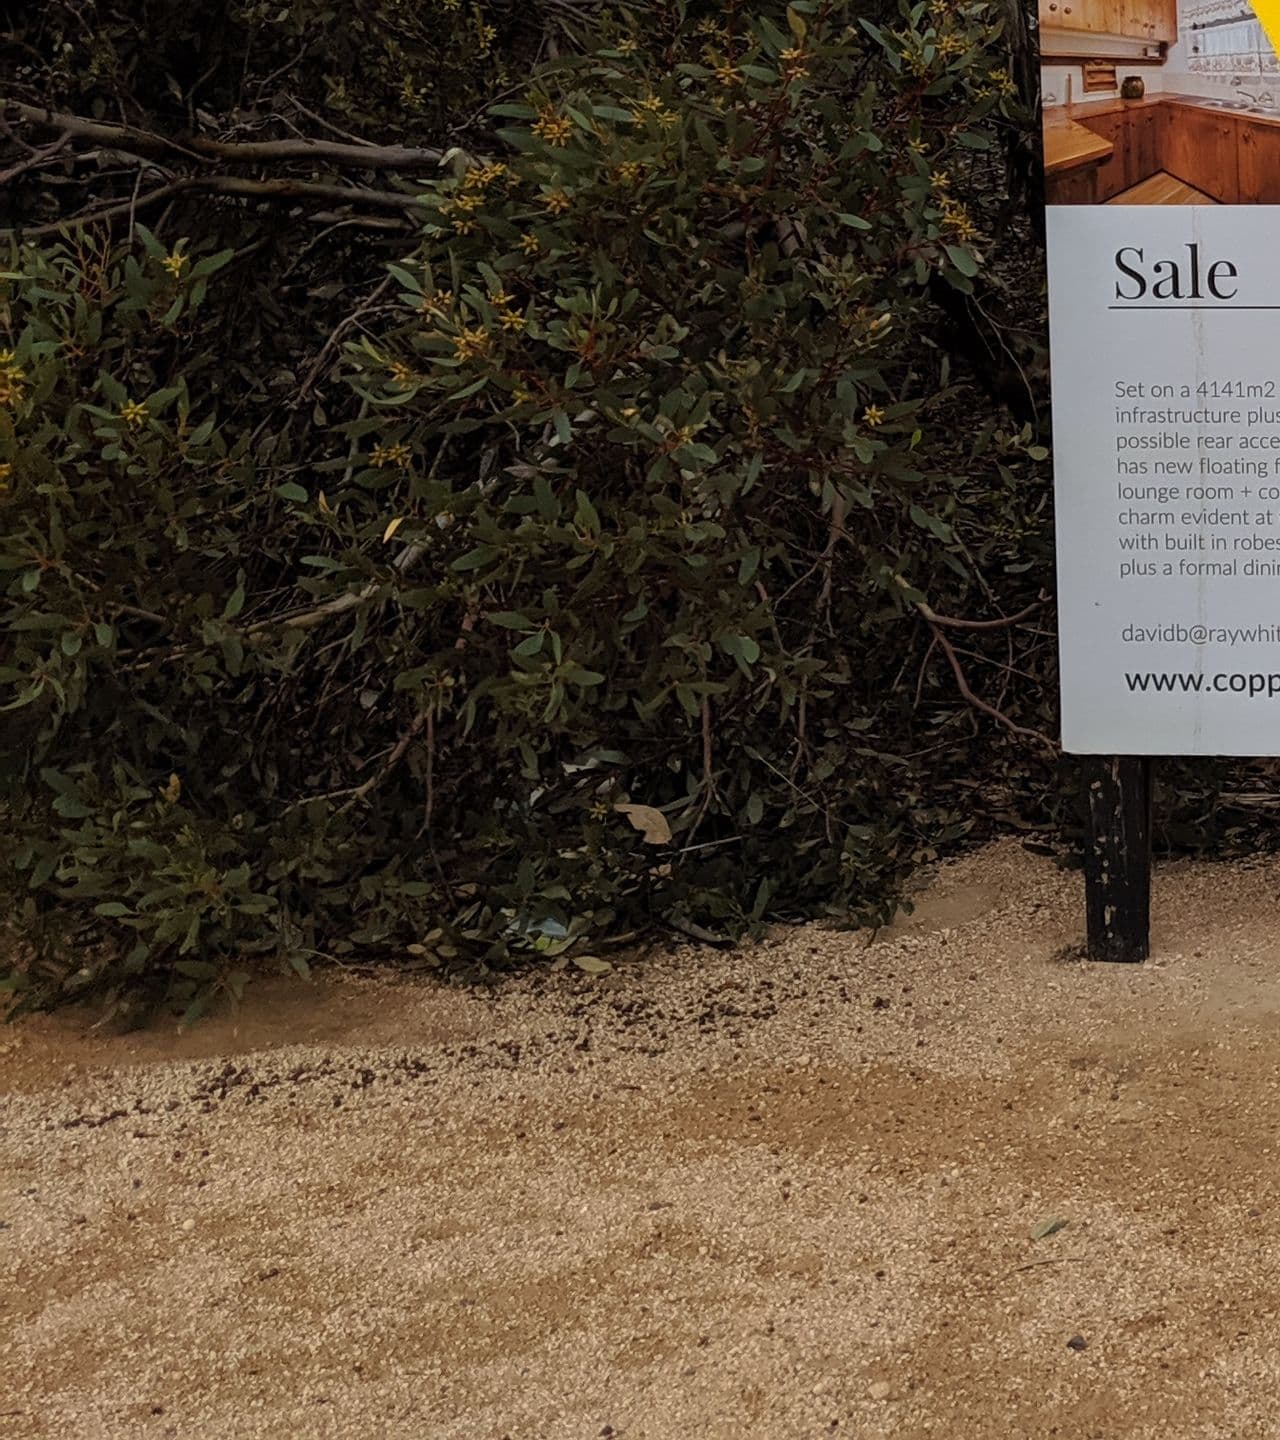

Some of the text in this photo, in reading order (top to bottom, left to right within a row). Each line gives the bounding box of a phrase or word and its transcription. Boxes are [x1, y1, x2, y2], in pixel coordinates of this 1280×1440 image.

[1114, 242, 1239, 300] Sale
[1115, 381, 1145, 398] Set
[1151, 385, 1174, 398] on
[1180, 385, 1190, 398] a
[1196, 381, 1275, 398] 4141m2
[1115, 406, 1240, 423] infrastructure
[1117, 432, 1190, 452] possible
[1197, 436, 1234, 449] rear
[1118, 456, 1148, 474] has
[1155, 462, 1193, 474] new
[1199, 457, 1268, 477] floating
[1118, 482, 1179, 503] lounge
[1186, 483, 1233, 499] room
[1119, 508, 1175, 525] charm
[1181, 508, 1250, 525] evident
[1255, 509, 1273, 525] at
[1119, 533, 1158, 550] with
[1166, 533, 1206, 550] built
[1211, 534, 1227, 550] in
[1120, 558, 1156, 579] plus
[1163, 563, 1172, 575] a
[1179, 559, 1236, 576] formal
